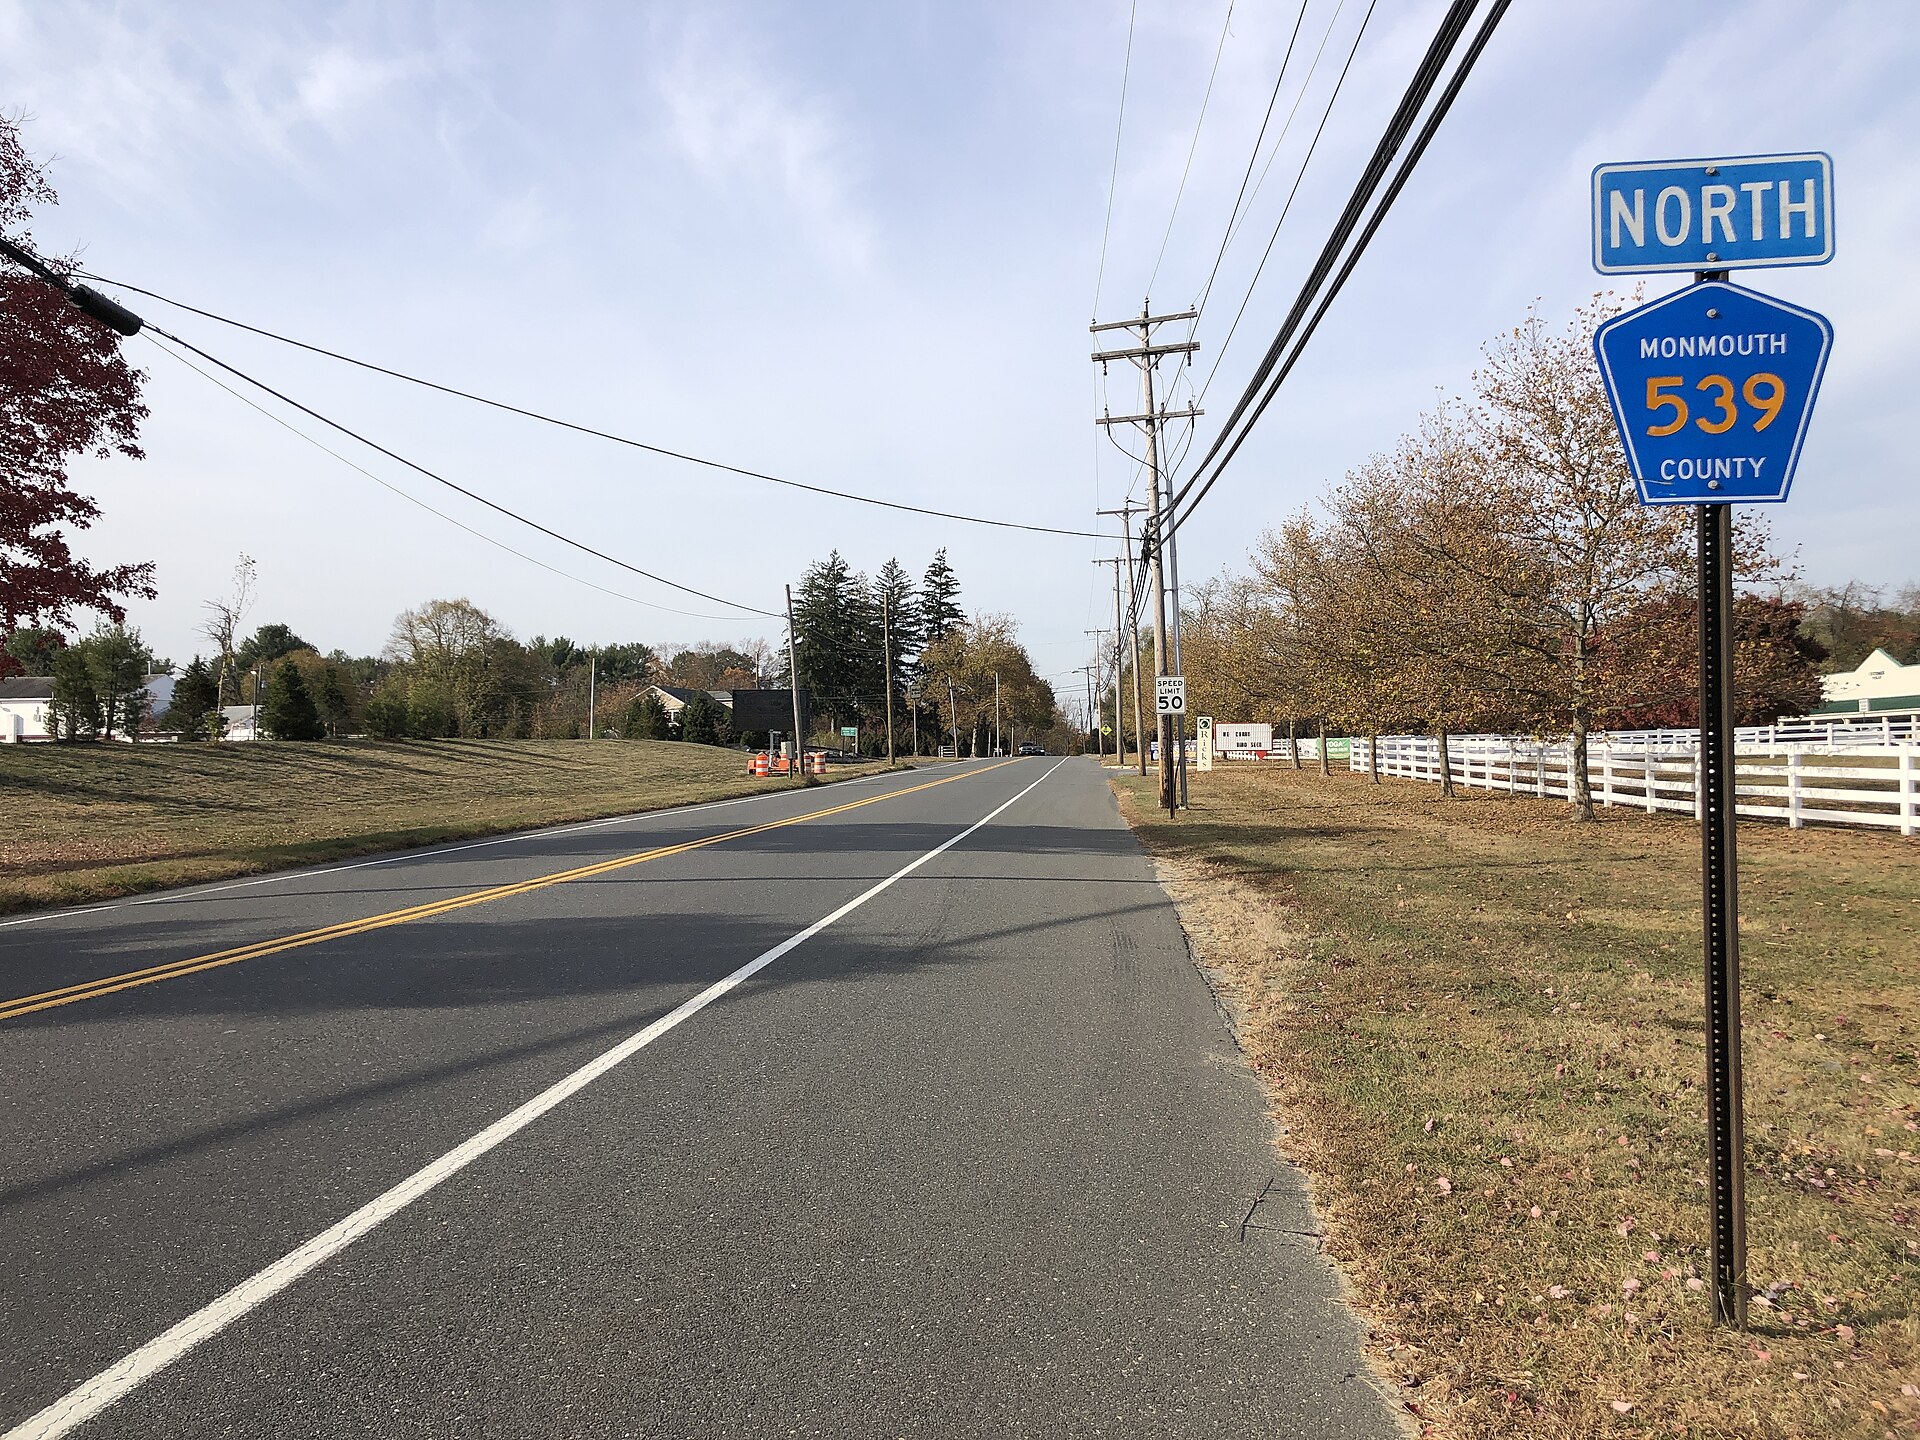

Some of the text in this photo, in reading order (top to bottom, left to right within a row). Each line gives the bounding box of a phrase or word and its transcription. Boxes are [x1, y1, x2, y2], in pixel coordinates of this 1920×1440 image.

[1609, 178, 1817, 249] NORTH
[1639, 333, 1788, 359] MONMOUTH
[1645, 372, 1787, 438] 539
[1659, 456, 1767, 482] COUNTY
[1158, 695, 1183, 710] 50
[1159, 687, 1181, 695] LIMIT
